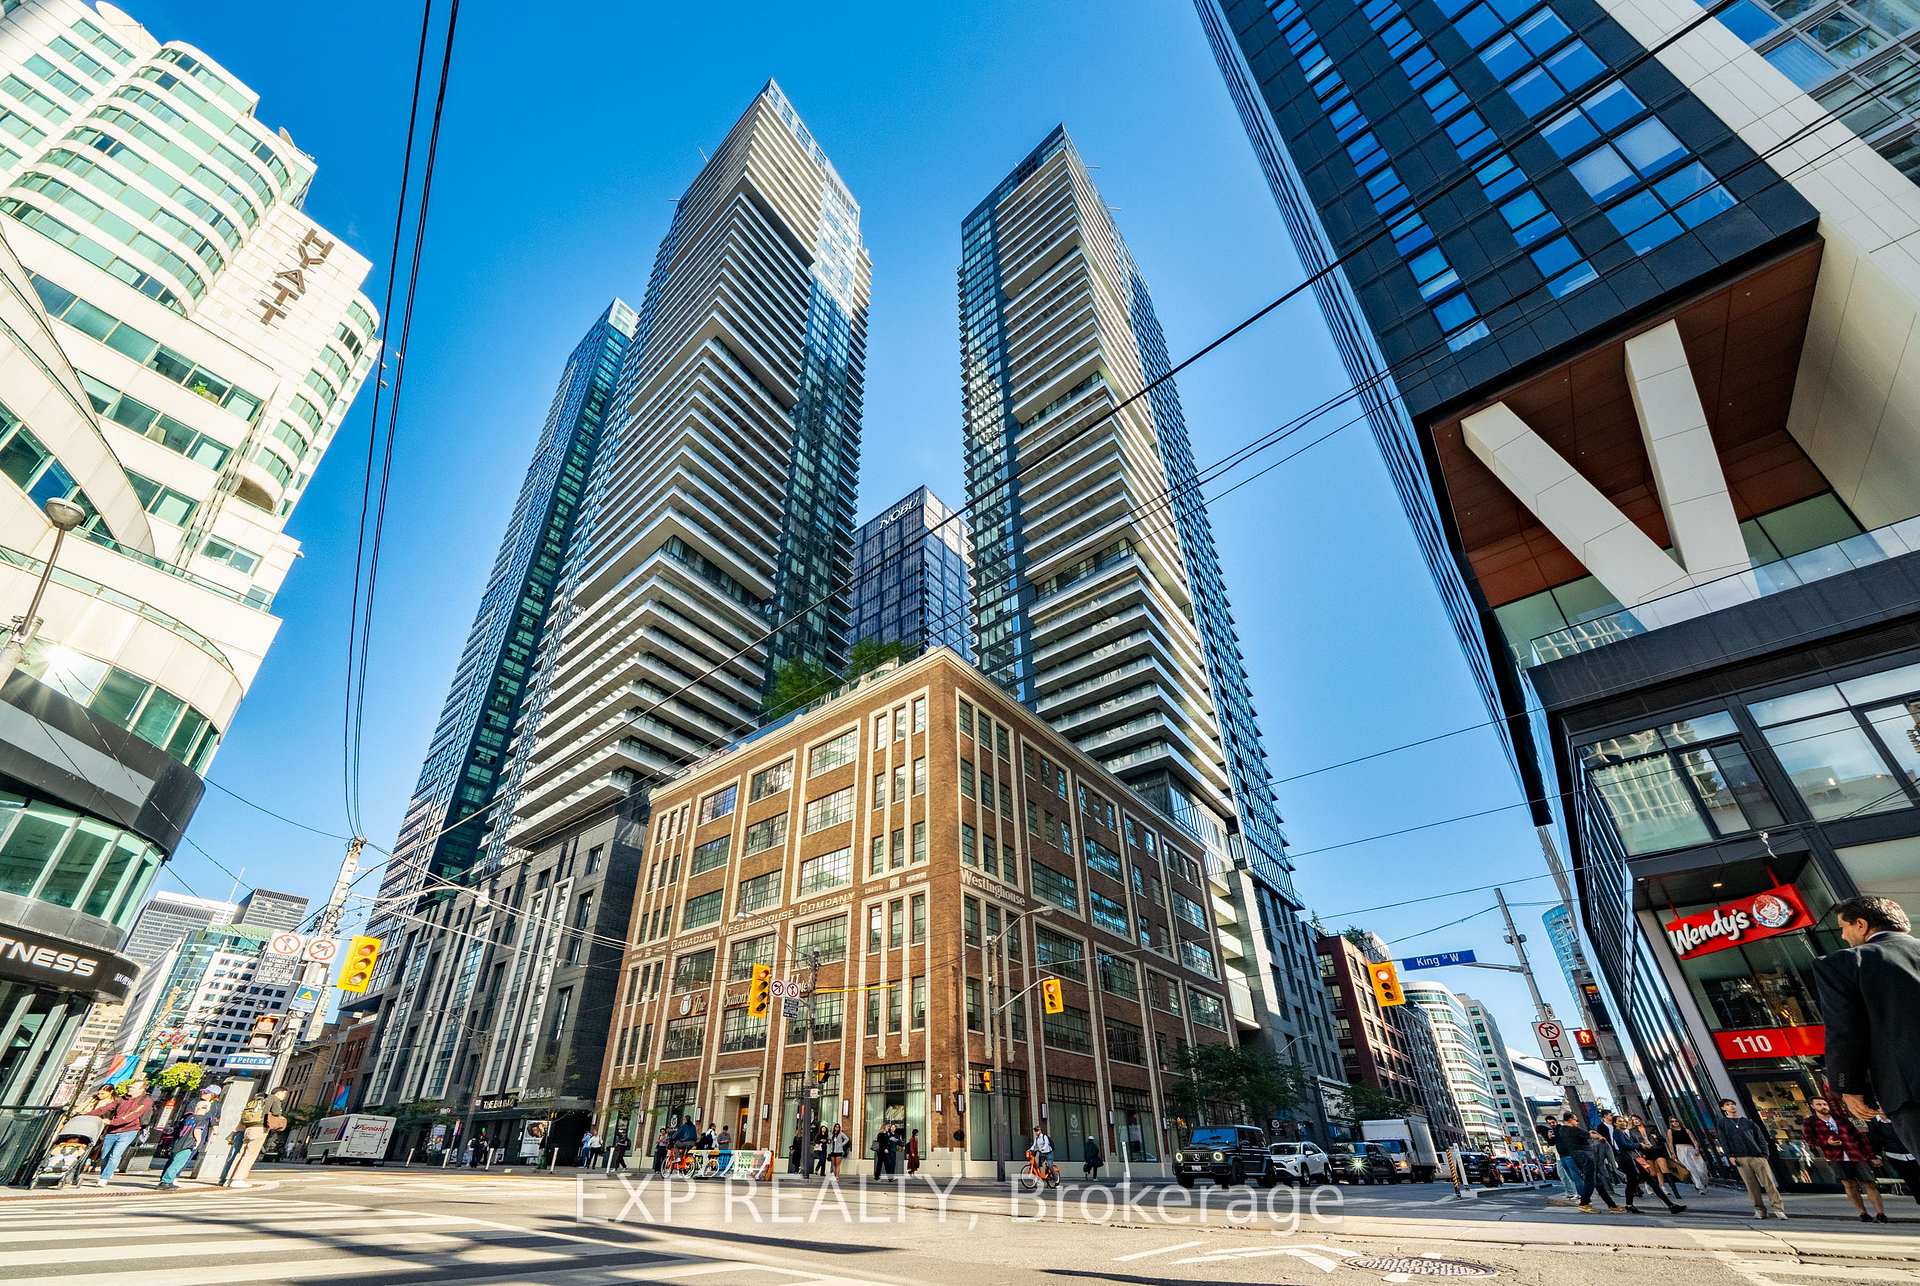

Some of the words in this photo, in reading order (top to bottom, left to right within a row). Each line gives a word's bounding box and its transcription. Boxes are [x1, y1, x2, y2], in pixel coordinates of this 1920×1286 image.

[258, 228, 335, 326] HYATT
[877, 496, 920, 530] NOBU
[960, 868, 1026, 907] Westinghouse
[671, 932, 714, 951] CANADIAN
[720, 908, 795, 937] WESTINGHOUSE
[799, 891, 856, 915] COMPANY
[1668, 909, 1750, 956] Wendy's
[1416, 957, 1440, 967] King
[1449, 953, 1460, 962] W
[1732, 1035, 1773, 1053] 110
